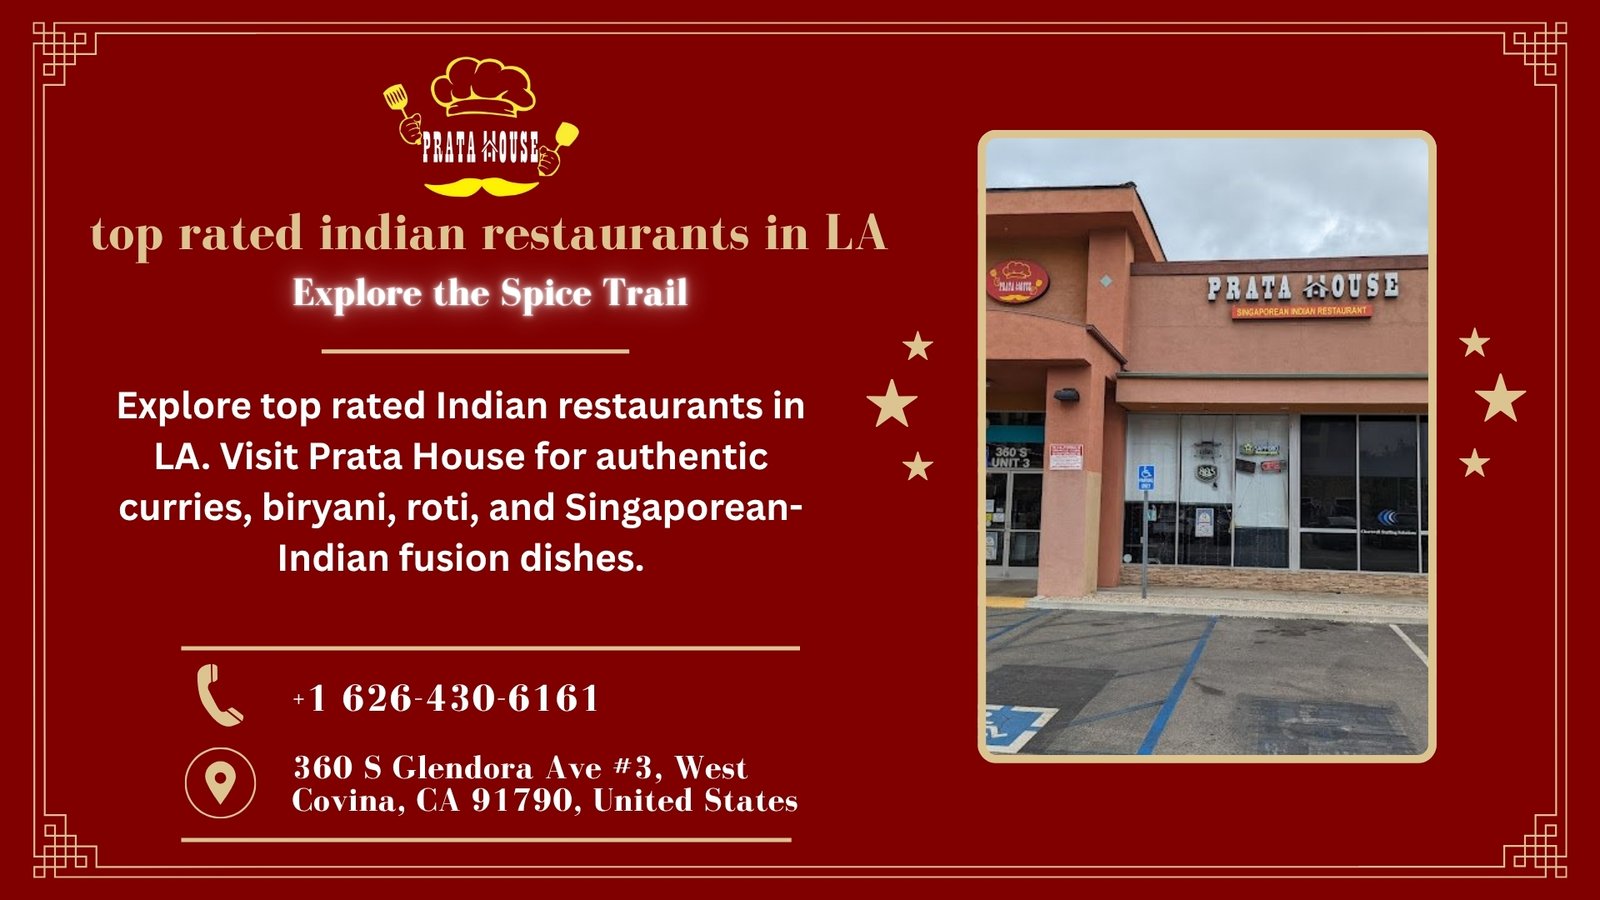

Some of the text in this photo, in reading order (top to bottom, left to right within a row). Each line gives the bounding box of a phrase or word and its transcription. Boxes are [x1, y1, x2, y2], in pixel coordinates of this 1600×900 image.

[1208, 272, 1399, 301] PRATA HOUSE
[1237, 306, 1367, 316] SINGAPOREAN INDIAN RESTAURANT
[995, 447, 1028, 457] 360 S
[992, 458, 1030, 468] UNIT 3
